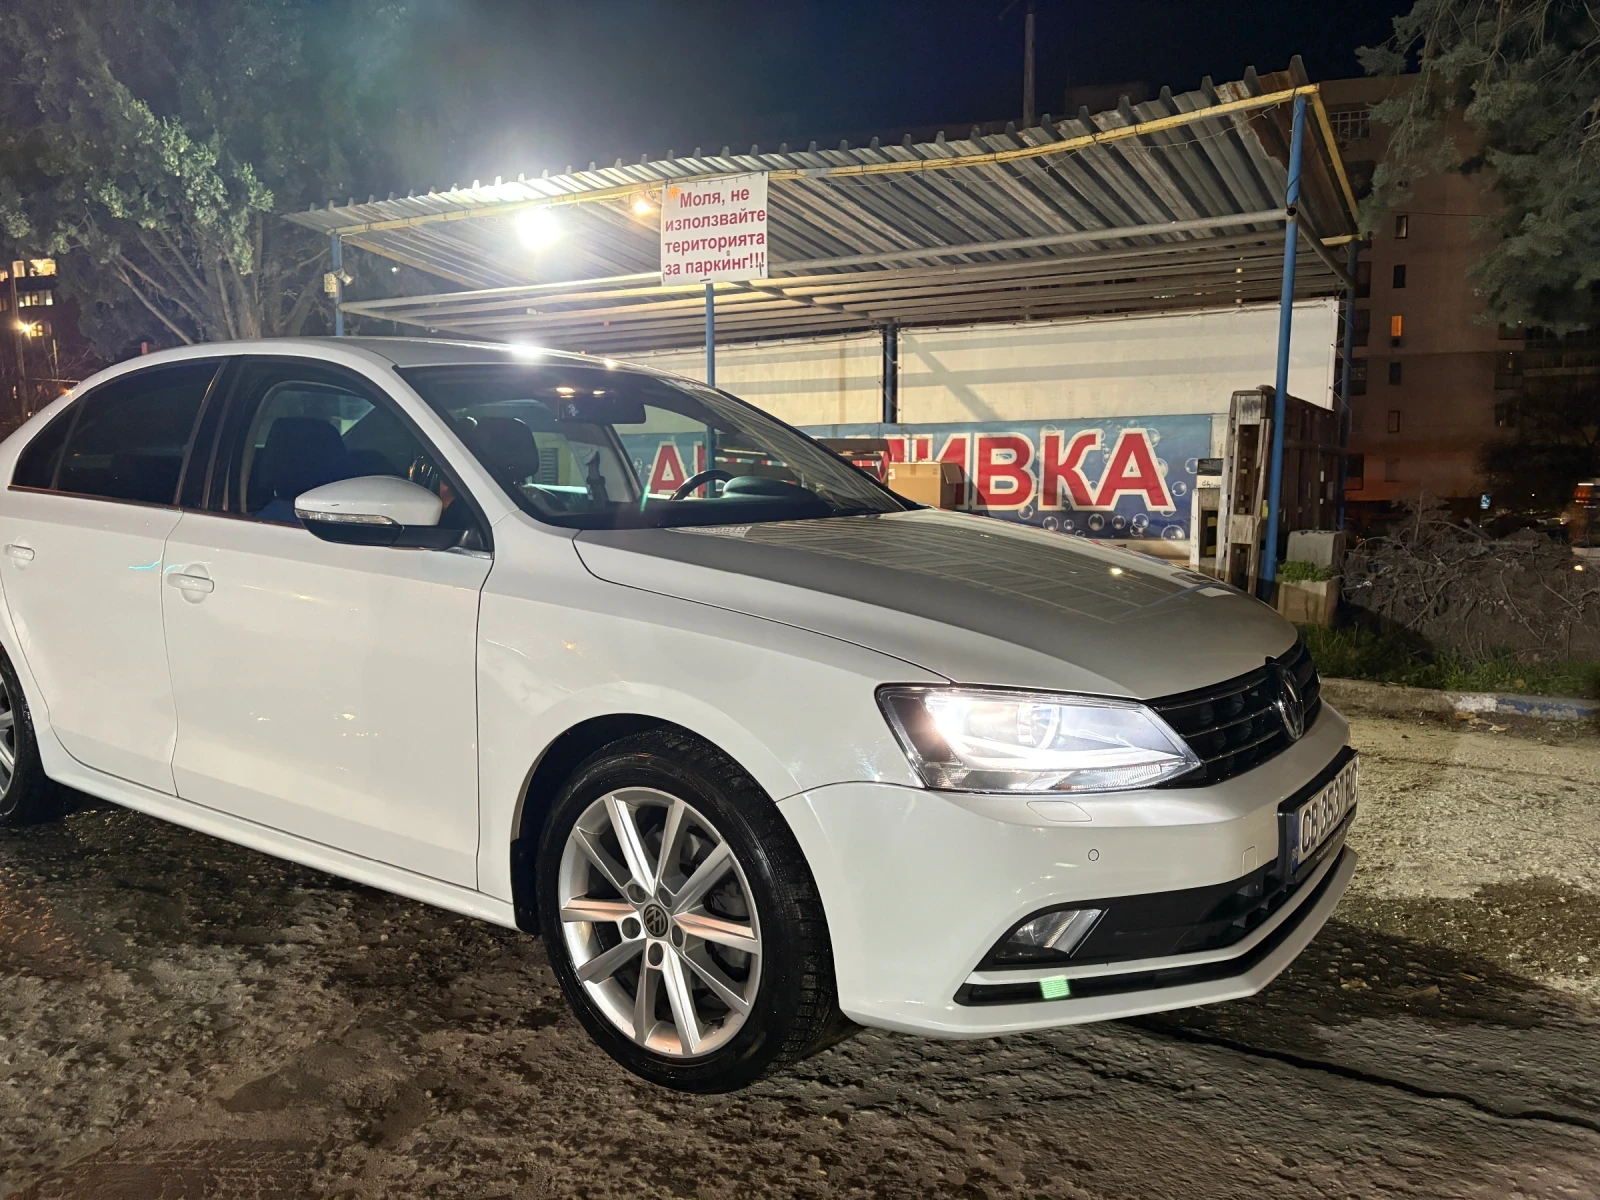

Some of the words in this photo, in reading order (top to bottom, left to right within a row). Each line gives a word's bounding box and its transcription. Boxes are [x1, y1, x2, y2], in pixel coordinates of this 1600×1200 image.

[680, 191, 725, 208] Моля,
[731, 188, 750, 202] не
[665, 207, 766, 232] използвайте
[665, 232, 765, 256] територията
[665, 262, 681, 276] за
[685, 252, 765, 276] паркинг!!!
